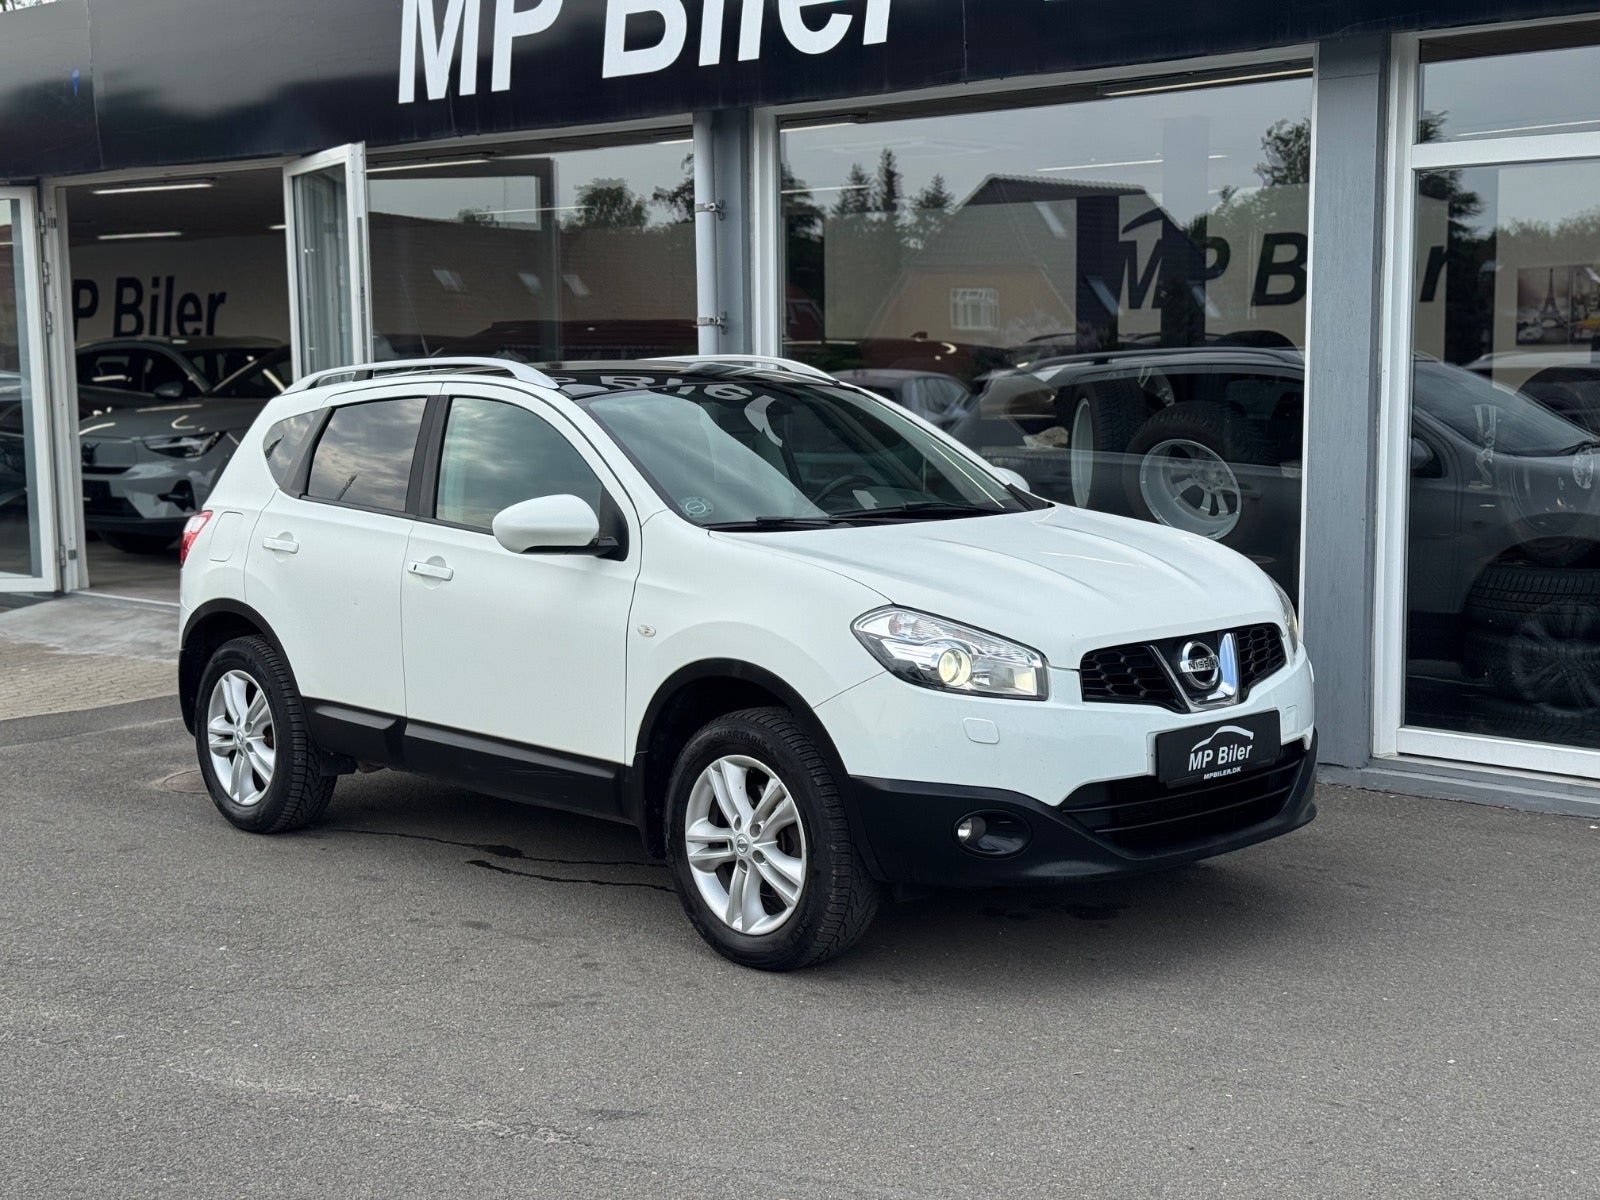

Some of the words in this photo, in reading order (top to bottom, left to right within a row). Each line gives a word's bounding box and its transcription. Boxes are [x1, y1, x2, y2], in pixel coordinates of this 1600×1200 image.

[398, 0, 562, 103] MP
[72, 279, 99, 342] P
[113, 275, 227, 338] Biler
[1188, 749, 1214, 772] MP
[1217, 743, 1253, 765] Biler
[1203, 765, 1242, 780] MPBILER.DK
